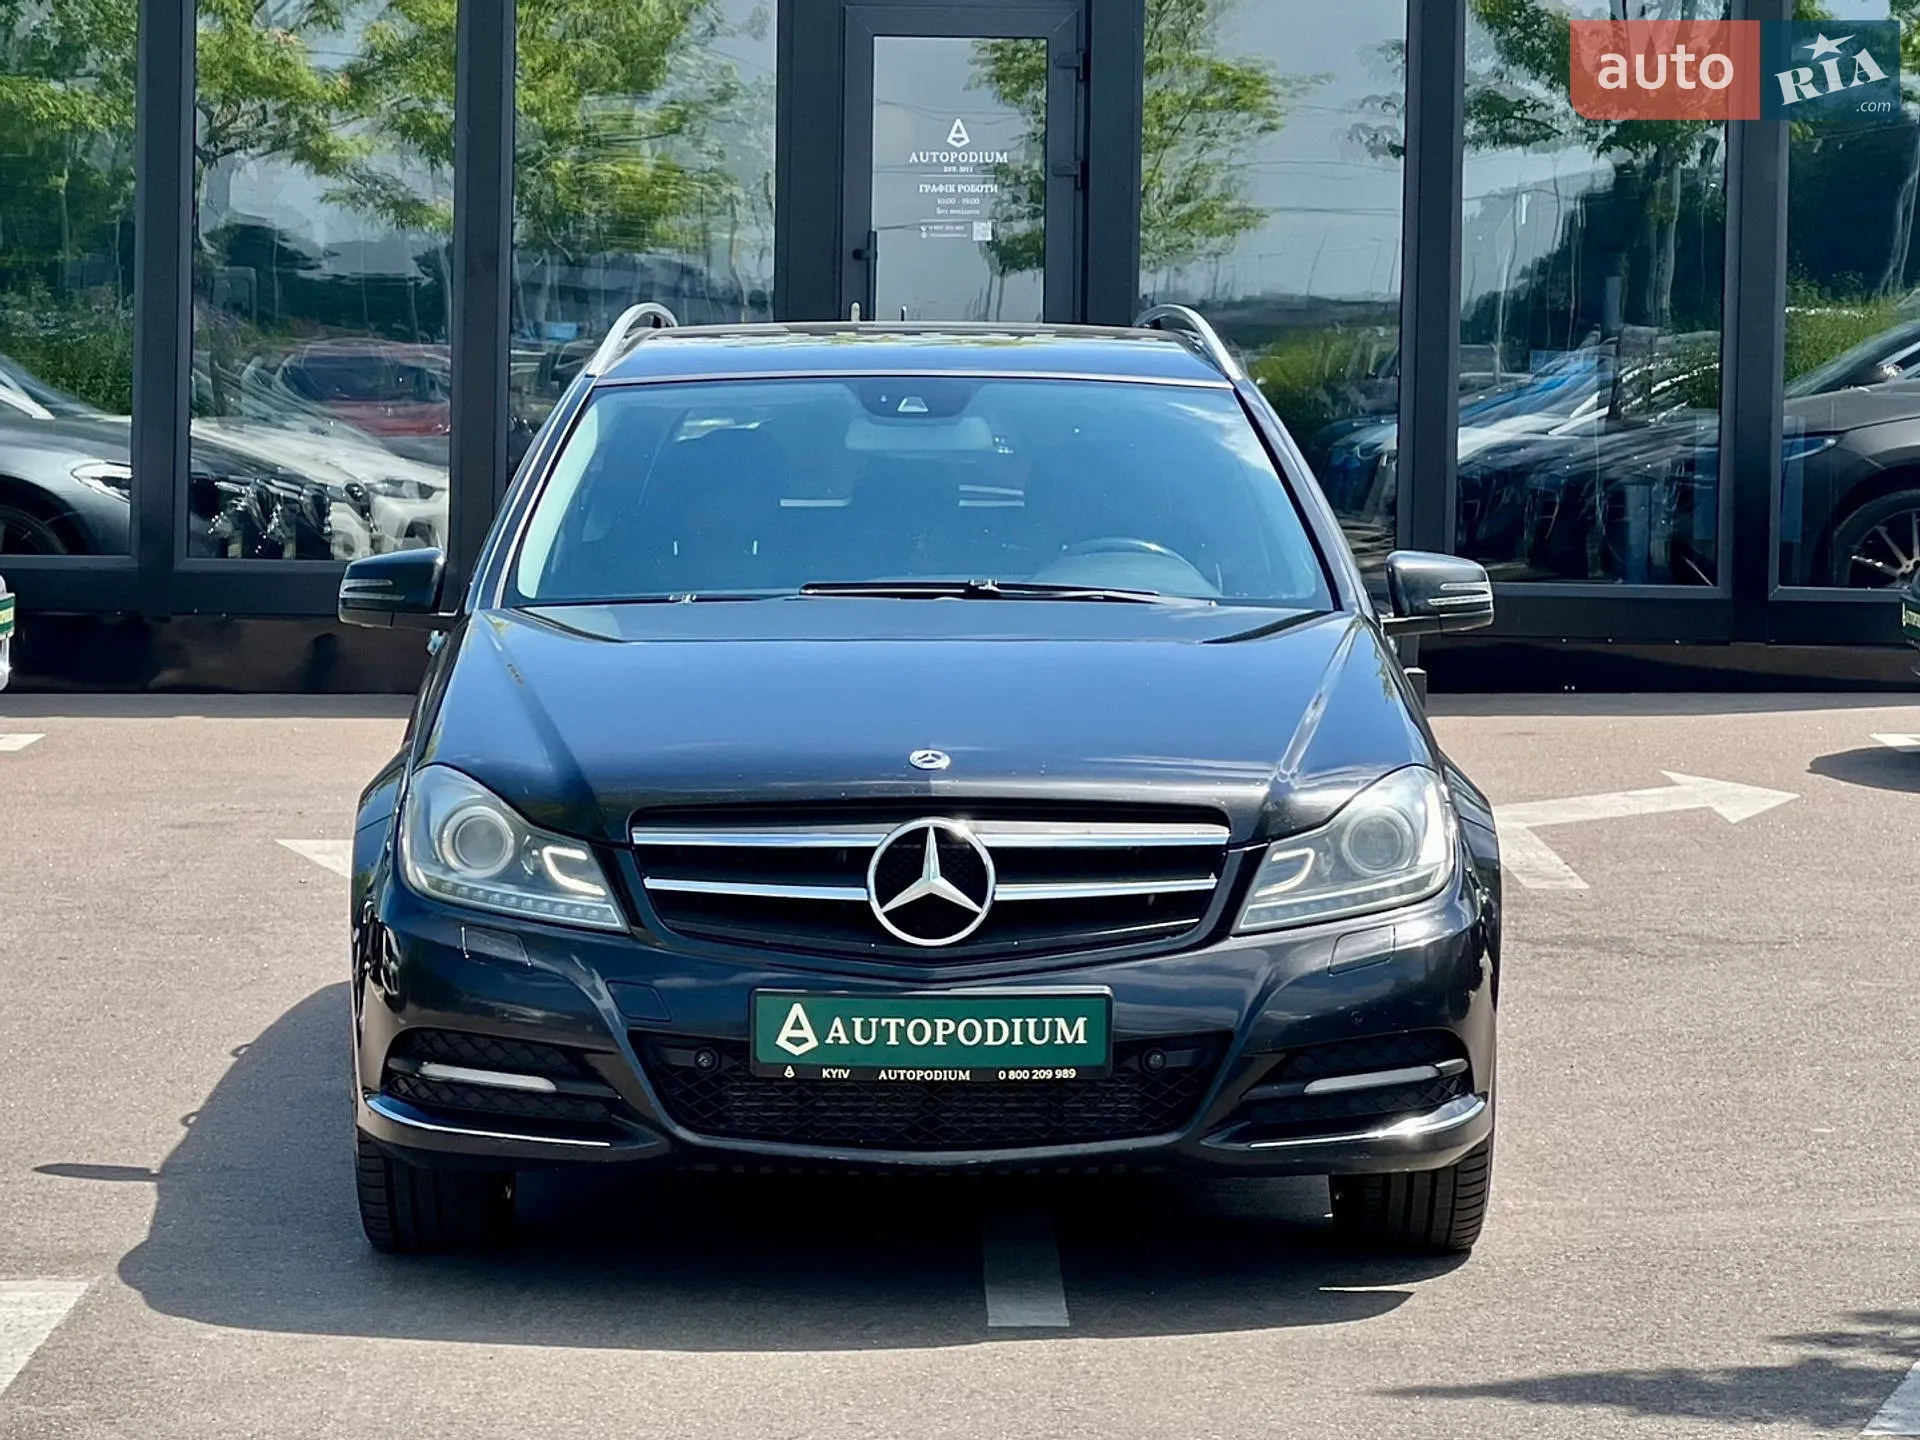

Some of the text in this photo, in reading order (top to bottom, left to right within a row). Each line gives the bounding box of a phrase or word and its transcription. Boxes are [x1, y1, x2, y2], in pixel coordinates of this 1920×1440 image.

[908, 151, 1009, 164] AUTOPODIUM
[919, 183, 999, 193] ГРАФІК РОБОТИ
[825, 1016, 1088, 1046] AUTOPODIUM
[822, 1067, 1077, 1081] KYIV AUTOPODIUM 0 800 209 989
